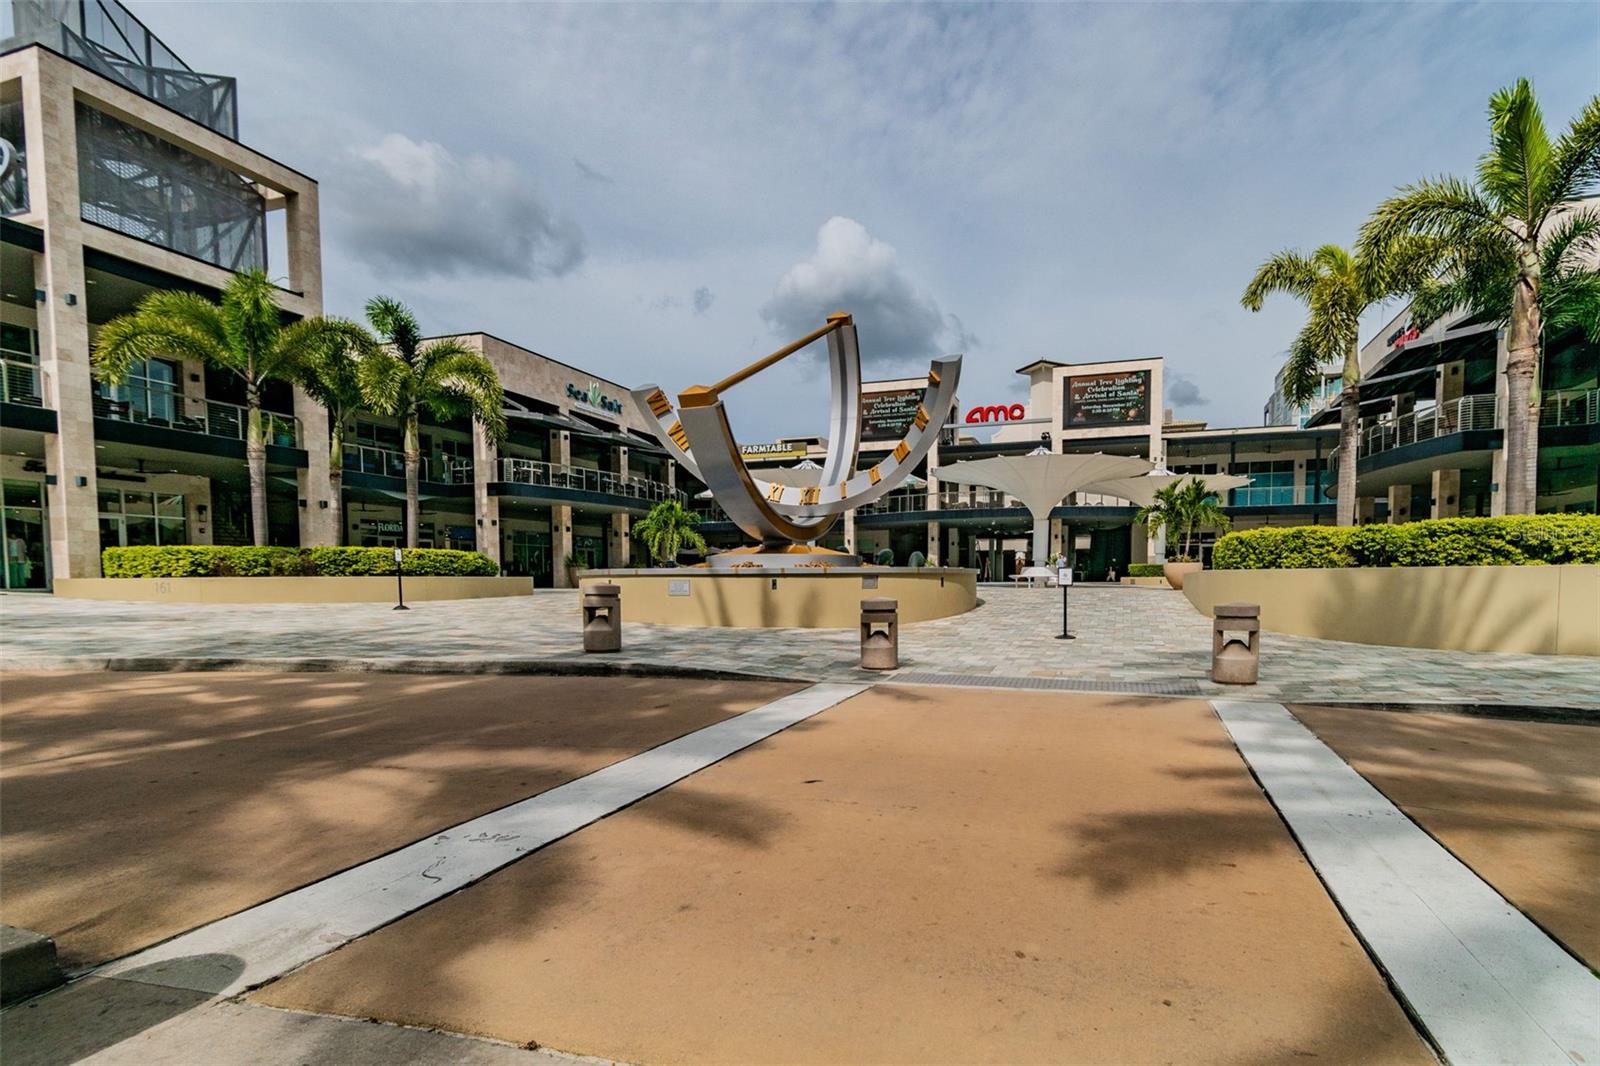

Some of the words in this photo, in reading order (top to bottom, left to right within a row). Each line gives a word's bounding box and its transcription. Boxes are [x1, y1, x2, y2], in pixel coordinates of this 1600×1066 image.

[1072, 380, 1097, 388] Annual
[1115, 377, 1143, 386] Lighting
[1087, 385, 1126, 393] Celebration
[566, 383, 588, 403] Sea
[600, 395, 623, 415] Salt
[1082, 391, 1107, 400] Arrival
[741, 443, 793, 454] FARMTABLE
